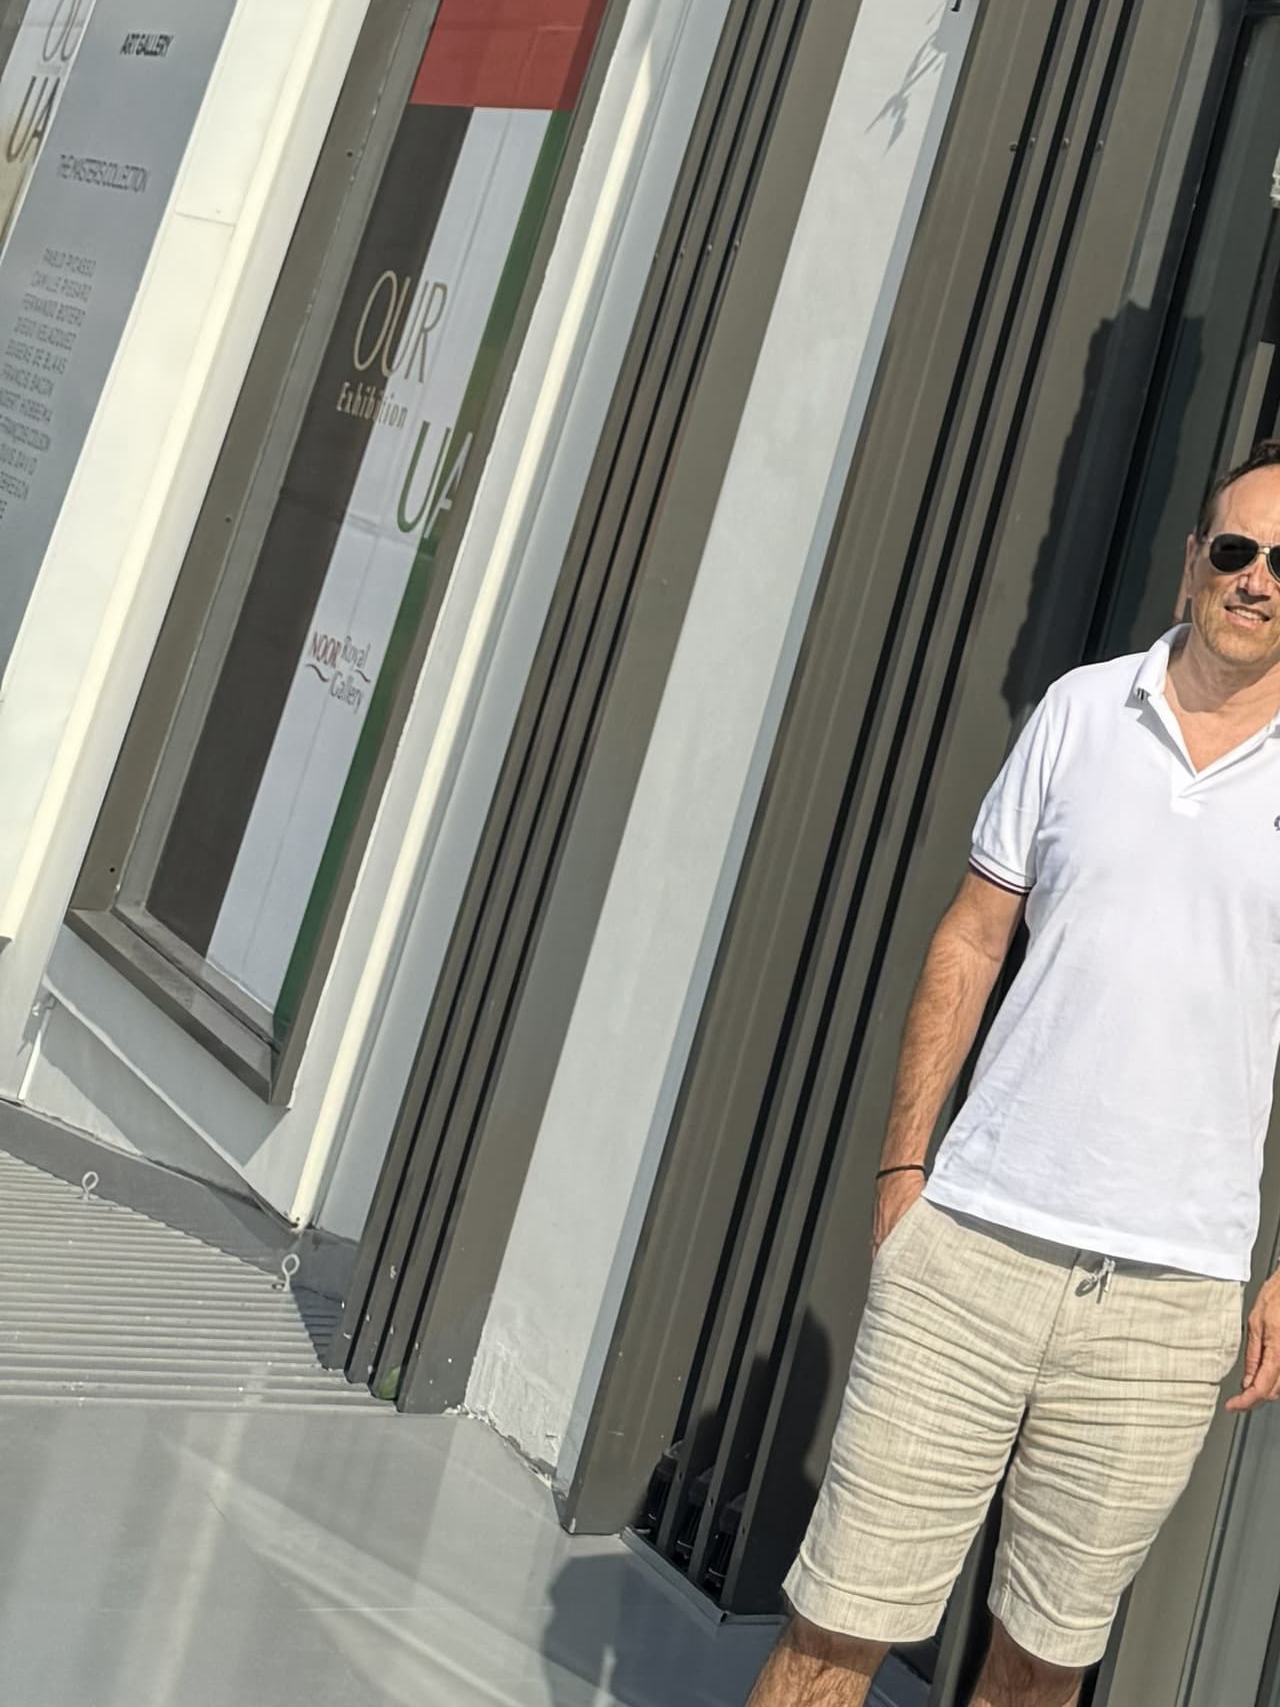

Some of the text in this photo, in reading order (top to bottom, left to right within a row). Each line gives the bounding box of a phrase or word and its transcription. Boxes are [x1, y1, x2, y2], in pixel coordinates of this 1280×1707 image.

[120, 33, 174, 58] ART GALLERY
[6, 75, 61, 164] UA
[353, 269, 448, 384] OUR
[335, 382, 409, 429] Exhibition
[396, 420, 474, 540] UA
